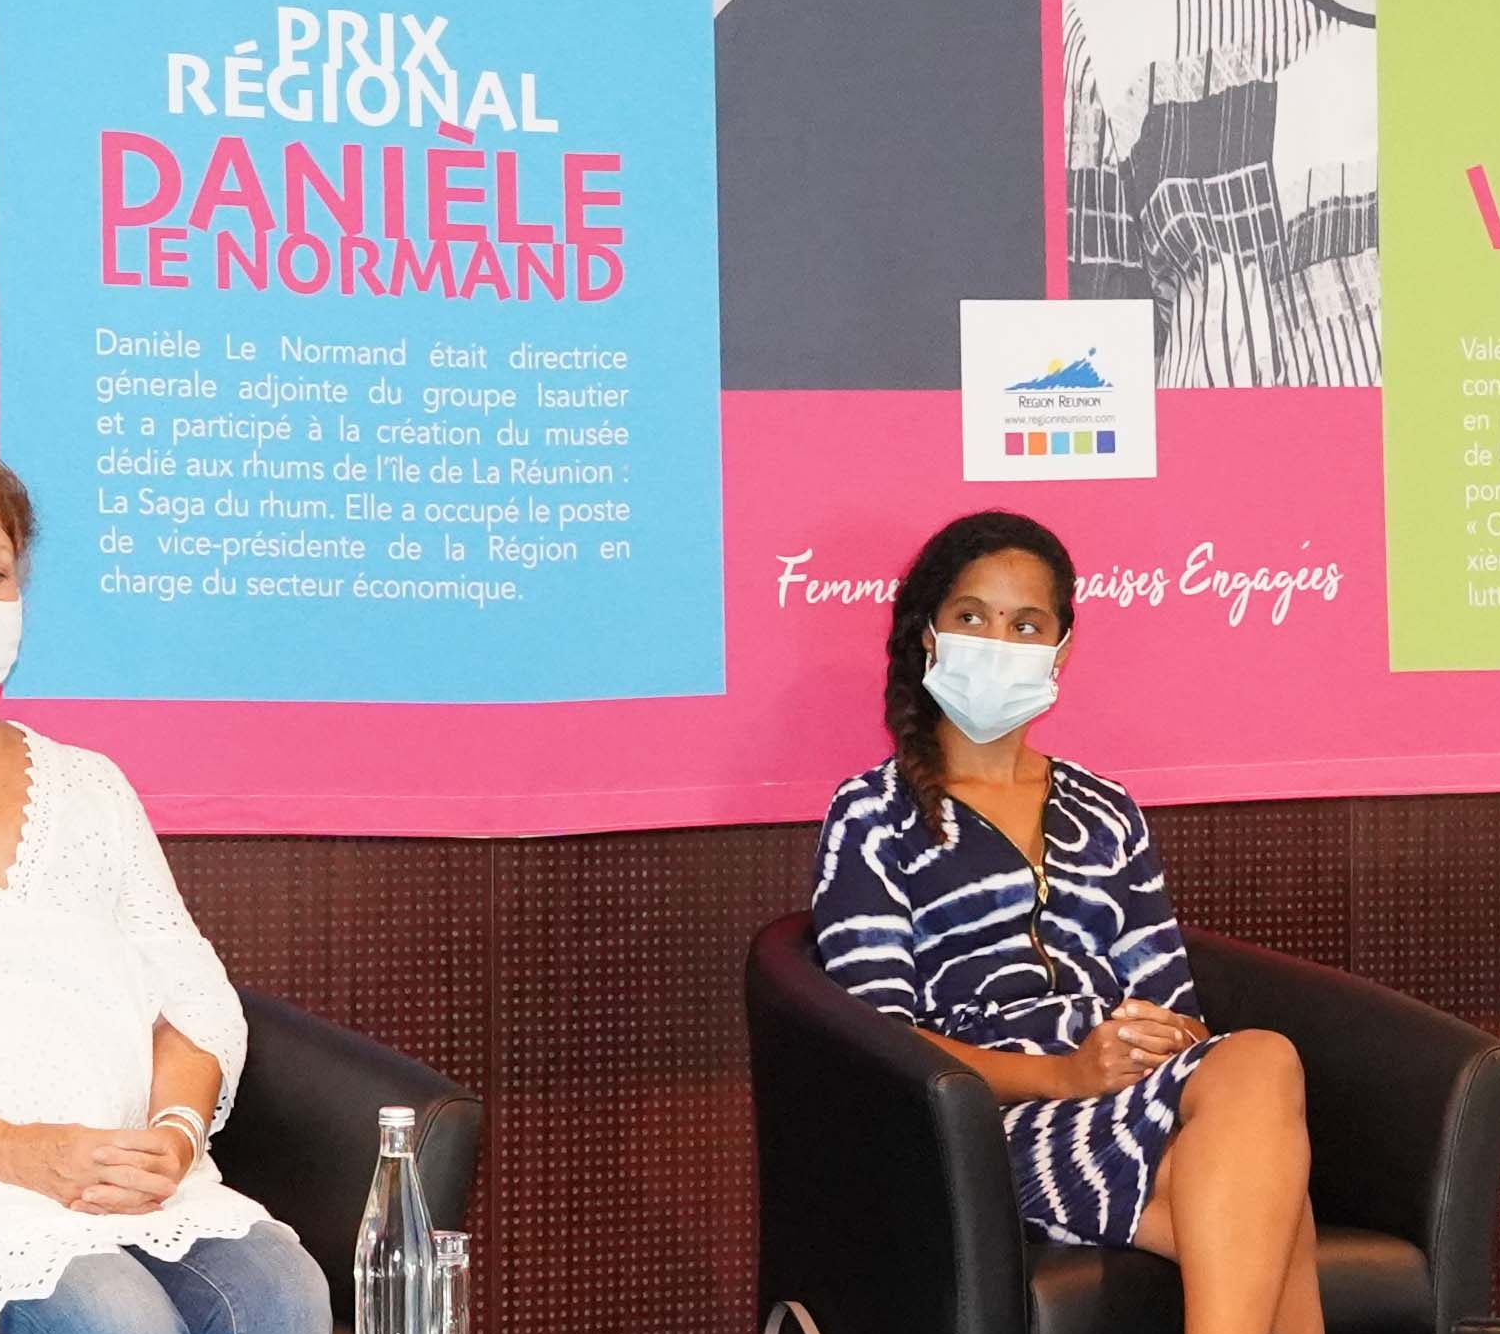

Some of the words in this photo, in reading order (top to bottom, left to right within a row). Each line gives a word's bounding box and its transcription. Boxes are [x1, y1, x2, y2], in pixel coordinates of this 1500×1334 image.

[277, 6, 450, 72] PRIX
[166, 40, 559, 132] RÉGIONAL
[100, 120, 624, 245] DANIÈLE
[101, 226, 190, 288] LE
[216, 228, 626, 303] NORMAND
[95, 327, 201, 359] Danièle
[226, 333, 257, 361] Le
[280, 335, 407, 366] Normand
[429, 342, 487, 369] était
[509, 342, 628, 370] directrice
[96, 369, 217, 404] génerale
[238, 373, 348, 408] adjointe
[368, 376, 402, 405] du
[423, 387, 517, 415] groupe
[537, 382, 629, 408] Isautier
[1018, 395, 1054, 408] REGION
[1059, 394, 1101, 408] REUNION
[96, 412, 125, 435] et
[140, 416, 155, 436] a
[172, 412, 292, 449] participé
[308, 415, 323, 441] à
[339, 414, 360, 443] la
[376, 418, 481, 445] création
[496, 418, 529, 446] du
[545, 420, 629, 446] musée
[1464, 415, 1489, 430] en
[96, 447, 177, 476] dédié
[186, 457, 234, 478] aux
[242, 450, 325, 481] rhums
[333, 454, 367, 482] de
[377, 455, 421, 483] l'île
[429, 456, 463, 484] de
[472, 458, 501, 484] La
[510, 458, 613, 485] Réunion
[1464, 443, 1492, 465] de
[98, 487, 129, 515] La
[138, 487, 205, 524] Saga
[214, 489, 249, 518] du
[259, 490, 334, 519] rhum.
[345, 492, 393, 521] Elle
[401, 502, 416, 522] a
[424, 497, 521, 532] occupé
[528, 496, 550, 524] le
[559, 500, 630, 532] poste
[99, 526, 134, 554] de
[157, 530, 366, 565] vice-présidente
[388, 533, 422, 561] de
[445, 534, 465, 562] la
[489, 535, 577, 569] Région
[599, 540, 630, 560] en
[100, 565, 193, 602] charge
[202, 568, 237, 596] du
[246, 574, 345, 597] secteur
[352, 572, 524, 608] économique.
[775, 547, 901, 609] Femme
[1179, 540, 1344, 627] Engagées
